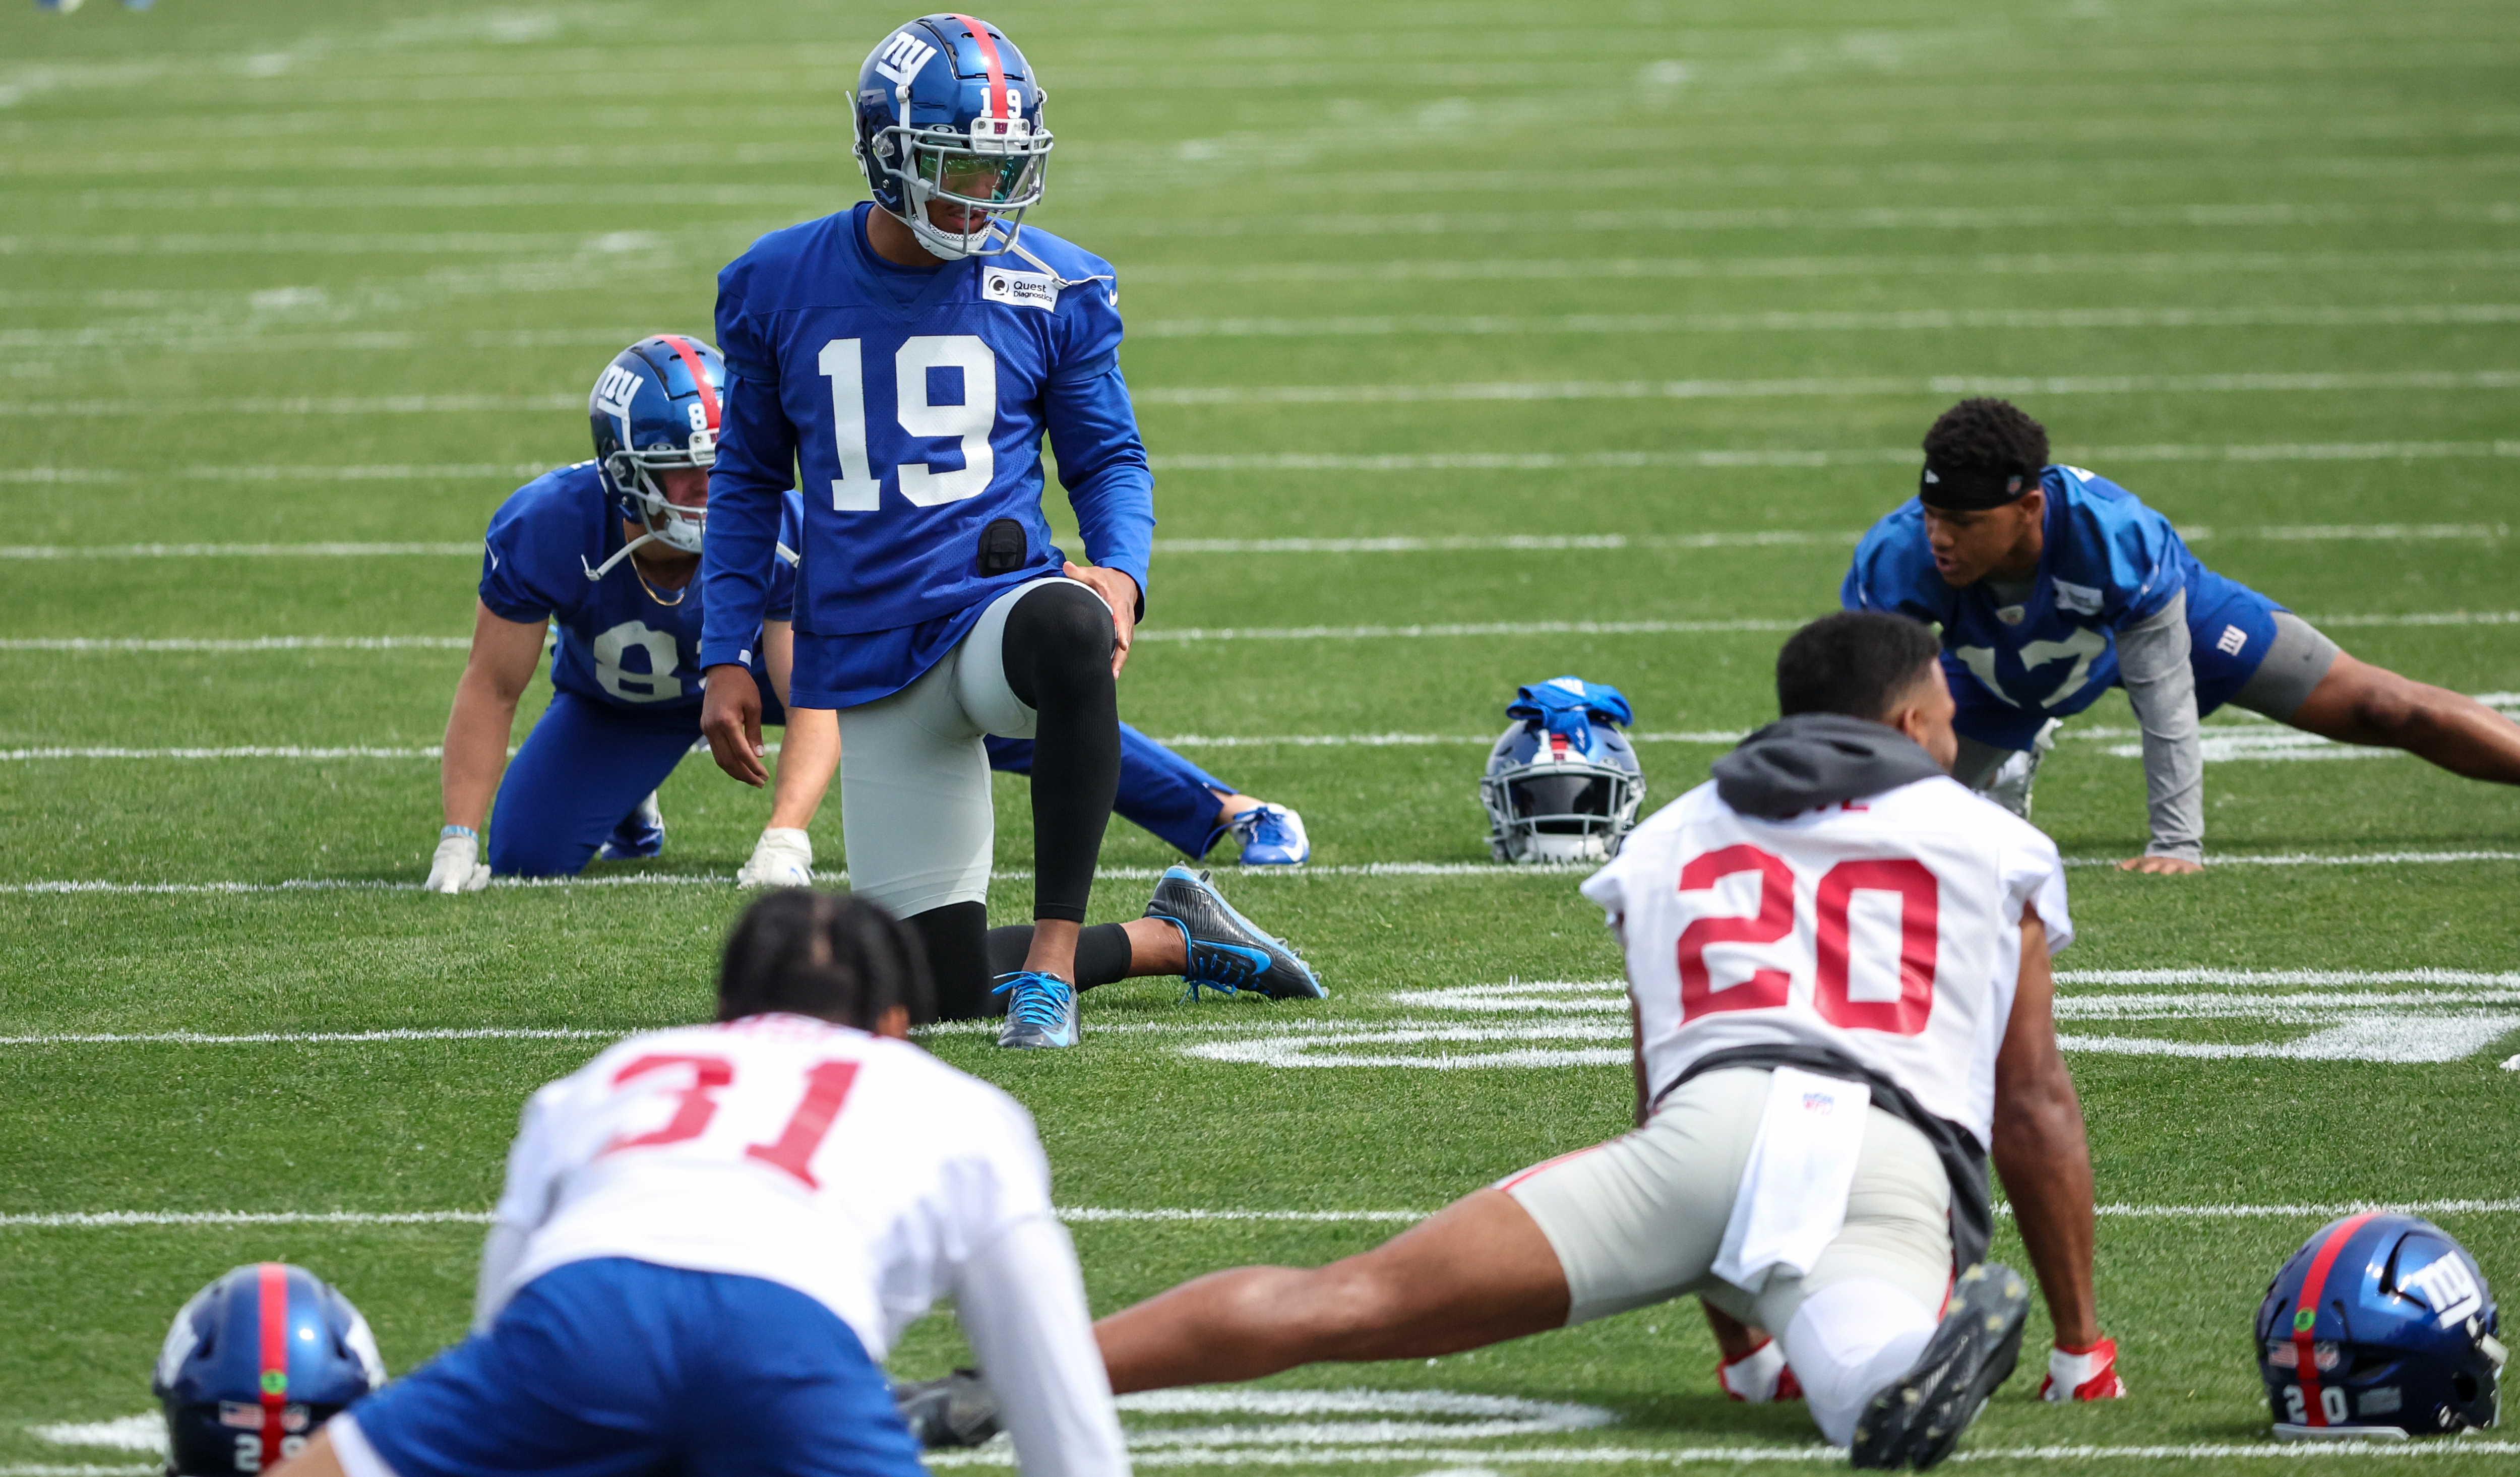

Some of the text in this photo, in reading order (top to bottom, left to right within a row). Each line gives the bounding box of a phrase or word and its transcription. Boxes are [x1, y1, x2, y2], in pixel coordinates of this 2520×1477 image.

[980, 87, 1022, 119] 19
[1014, 281, 1047, 292] Quest
[1014, 290, 1053, 302] Diagnostics
[818, 335, 997, 511] 19
[593, 620, 706, 703] 8
[1956, 626, 2106, 709] 17
[1676, 842, 1939, 1036] 20
[597, 1055, 860, 1191] 31
[2283, 1384, 2349, 1425] 20
